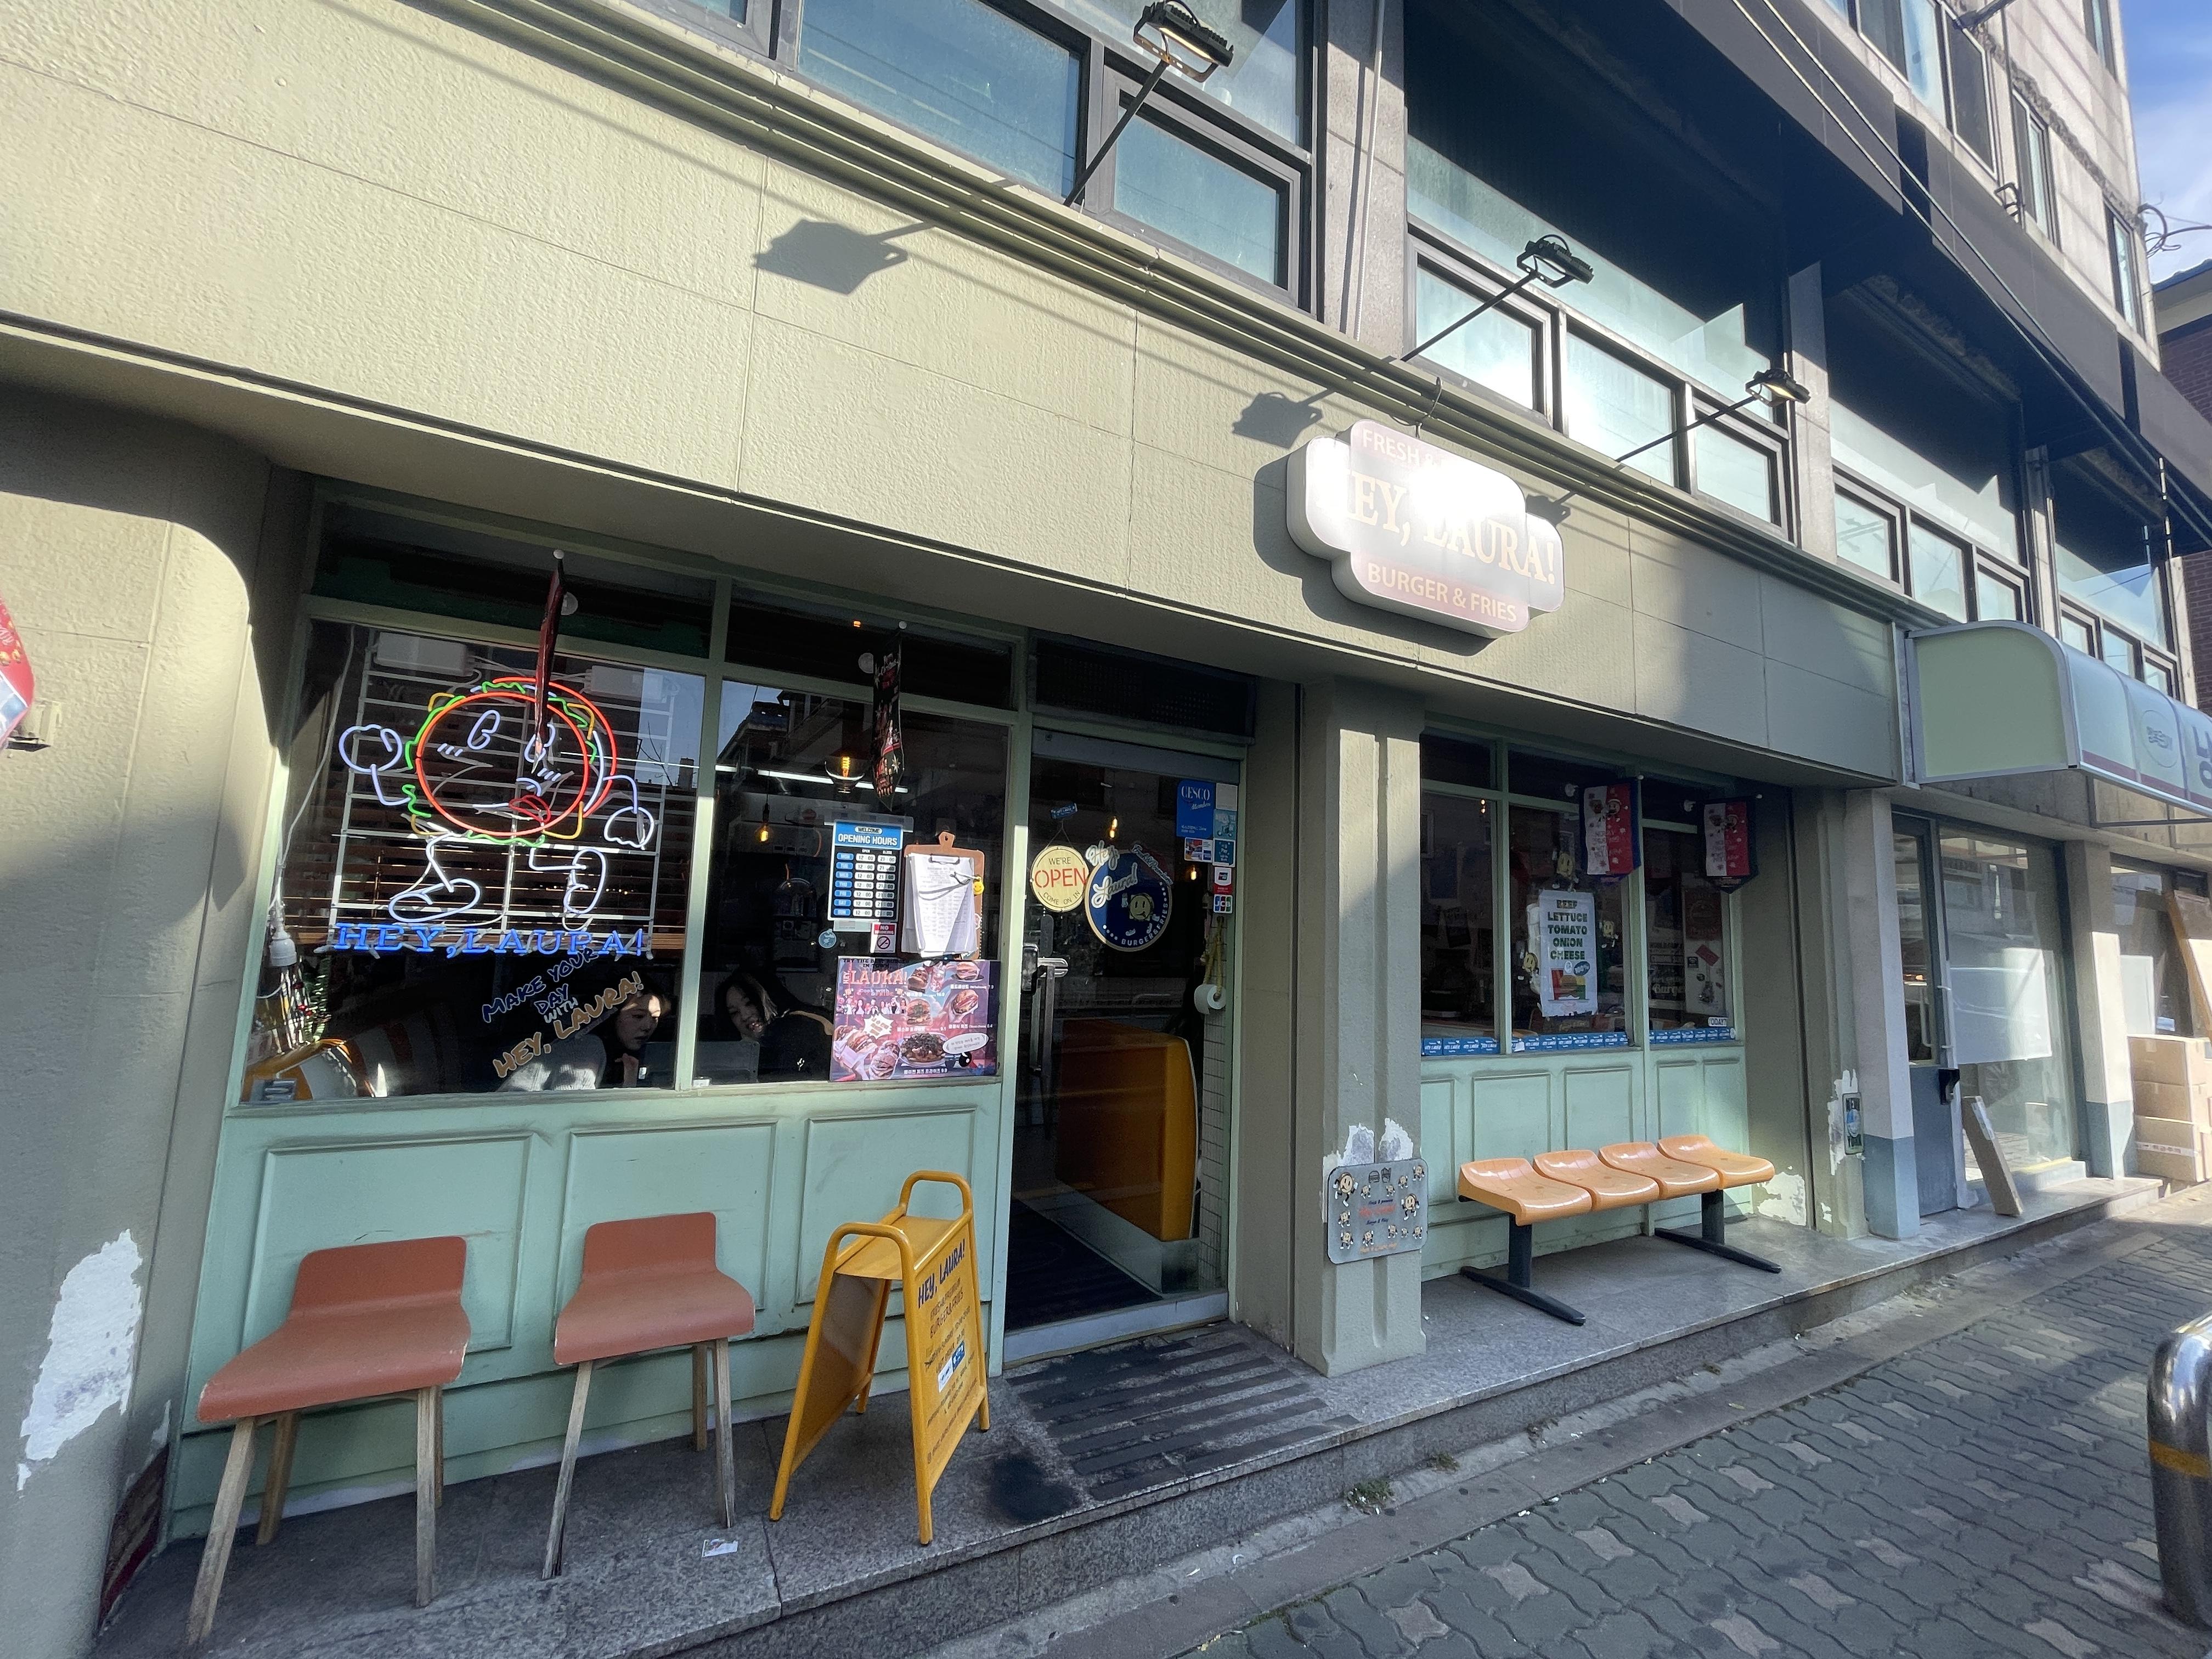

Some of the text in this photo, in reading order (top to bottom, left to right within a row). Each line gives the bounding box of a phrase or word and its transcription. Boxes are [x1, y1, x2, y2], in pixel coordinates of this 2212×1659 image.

[1362, 428, 1420, 466] FRESH
[1338, 465, 1412, 547] EY,
[1368, 562, 1517, 622] BURGER & FRIES
[1181, 786, 1210, 801] CESCO
[838, 833, 898, 846] OPENING HOURS
[1048, 857, 1071, 865] WE'RE
[1035, 867, 1087, 888] OPEN
[1043, 892, 1059, 905] COME
[1074, 891, 1081, 899] IN
[1556, 899, 1578, 909] BEEF
[1547, 911, 1588, 922] LETTUCE
[1547, 924, 1588, 935] TOMATO
[334, 921, 457, 958] HEY,
[1553, 937, 1583, 947] ONION
[1550, 950, 1585, 960] CHEESE
[482, 947, 599, 1023] MAKE YOUR
[851, 969, 907, 985] LAURA!
[534, 983, 568, 1014] DAY
[544, 997, 578, 1023] WITH
[493, 970, 644, 1078] HEY, LAURA!
[918, 1273, 937, 1310] HEY,
[939, 1238, 966, 1285] LAURA!
